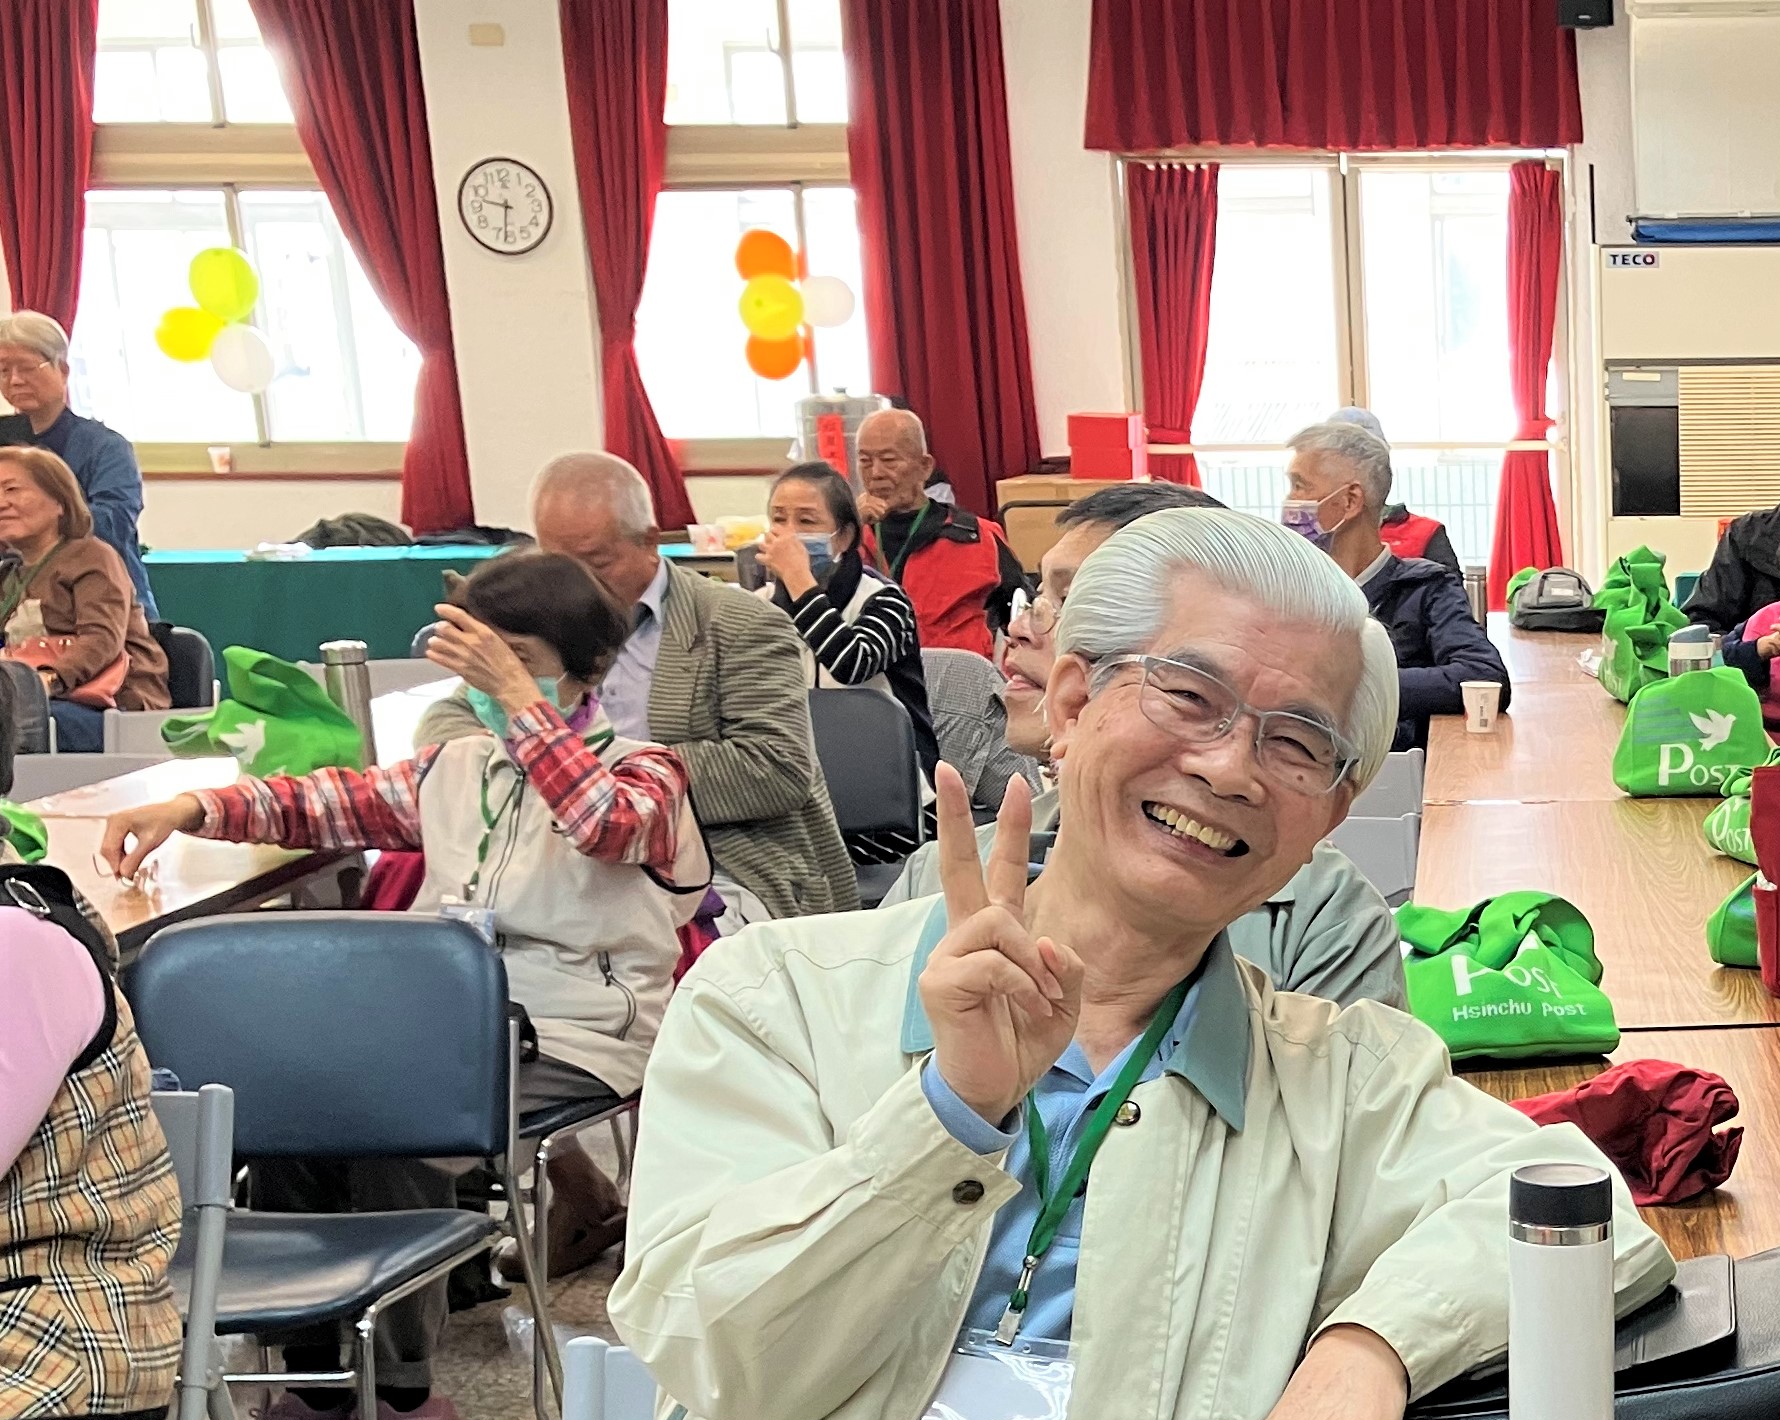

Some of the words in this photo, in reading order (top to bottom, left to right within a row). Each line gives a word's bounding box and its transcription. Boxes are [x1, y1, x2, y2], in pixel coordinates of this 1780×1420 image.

[483, 172, 495, 185] 11
[496, 167, 510, 182] 12
[471, 184, 488, 198] 10
[524, 183, 536, 198] 2
[471, 200, 482, 213] 9
[532, 199, 542, 213] 3
[478, 215, 488, 229] 8
[528, 215, 539, 227] 4
[491, 226, 503, 240] 7
[519, 226, 531, 240] 5
[1609, 253, 1655, 266] TECO
[1452, 999, 1532, 1022] Hsinchu
[1541, 1002, 1587, 1017] Post
